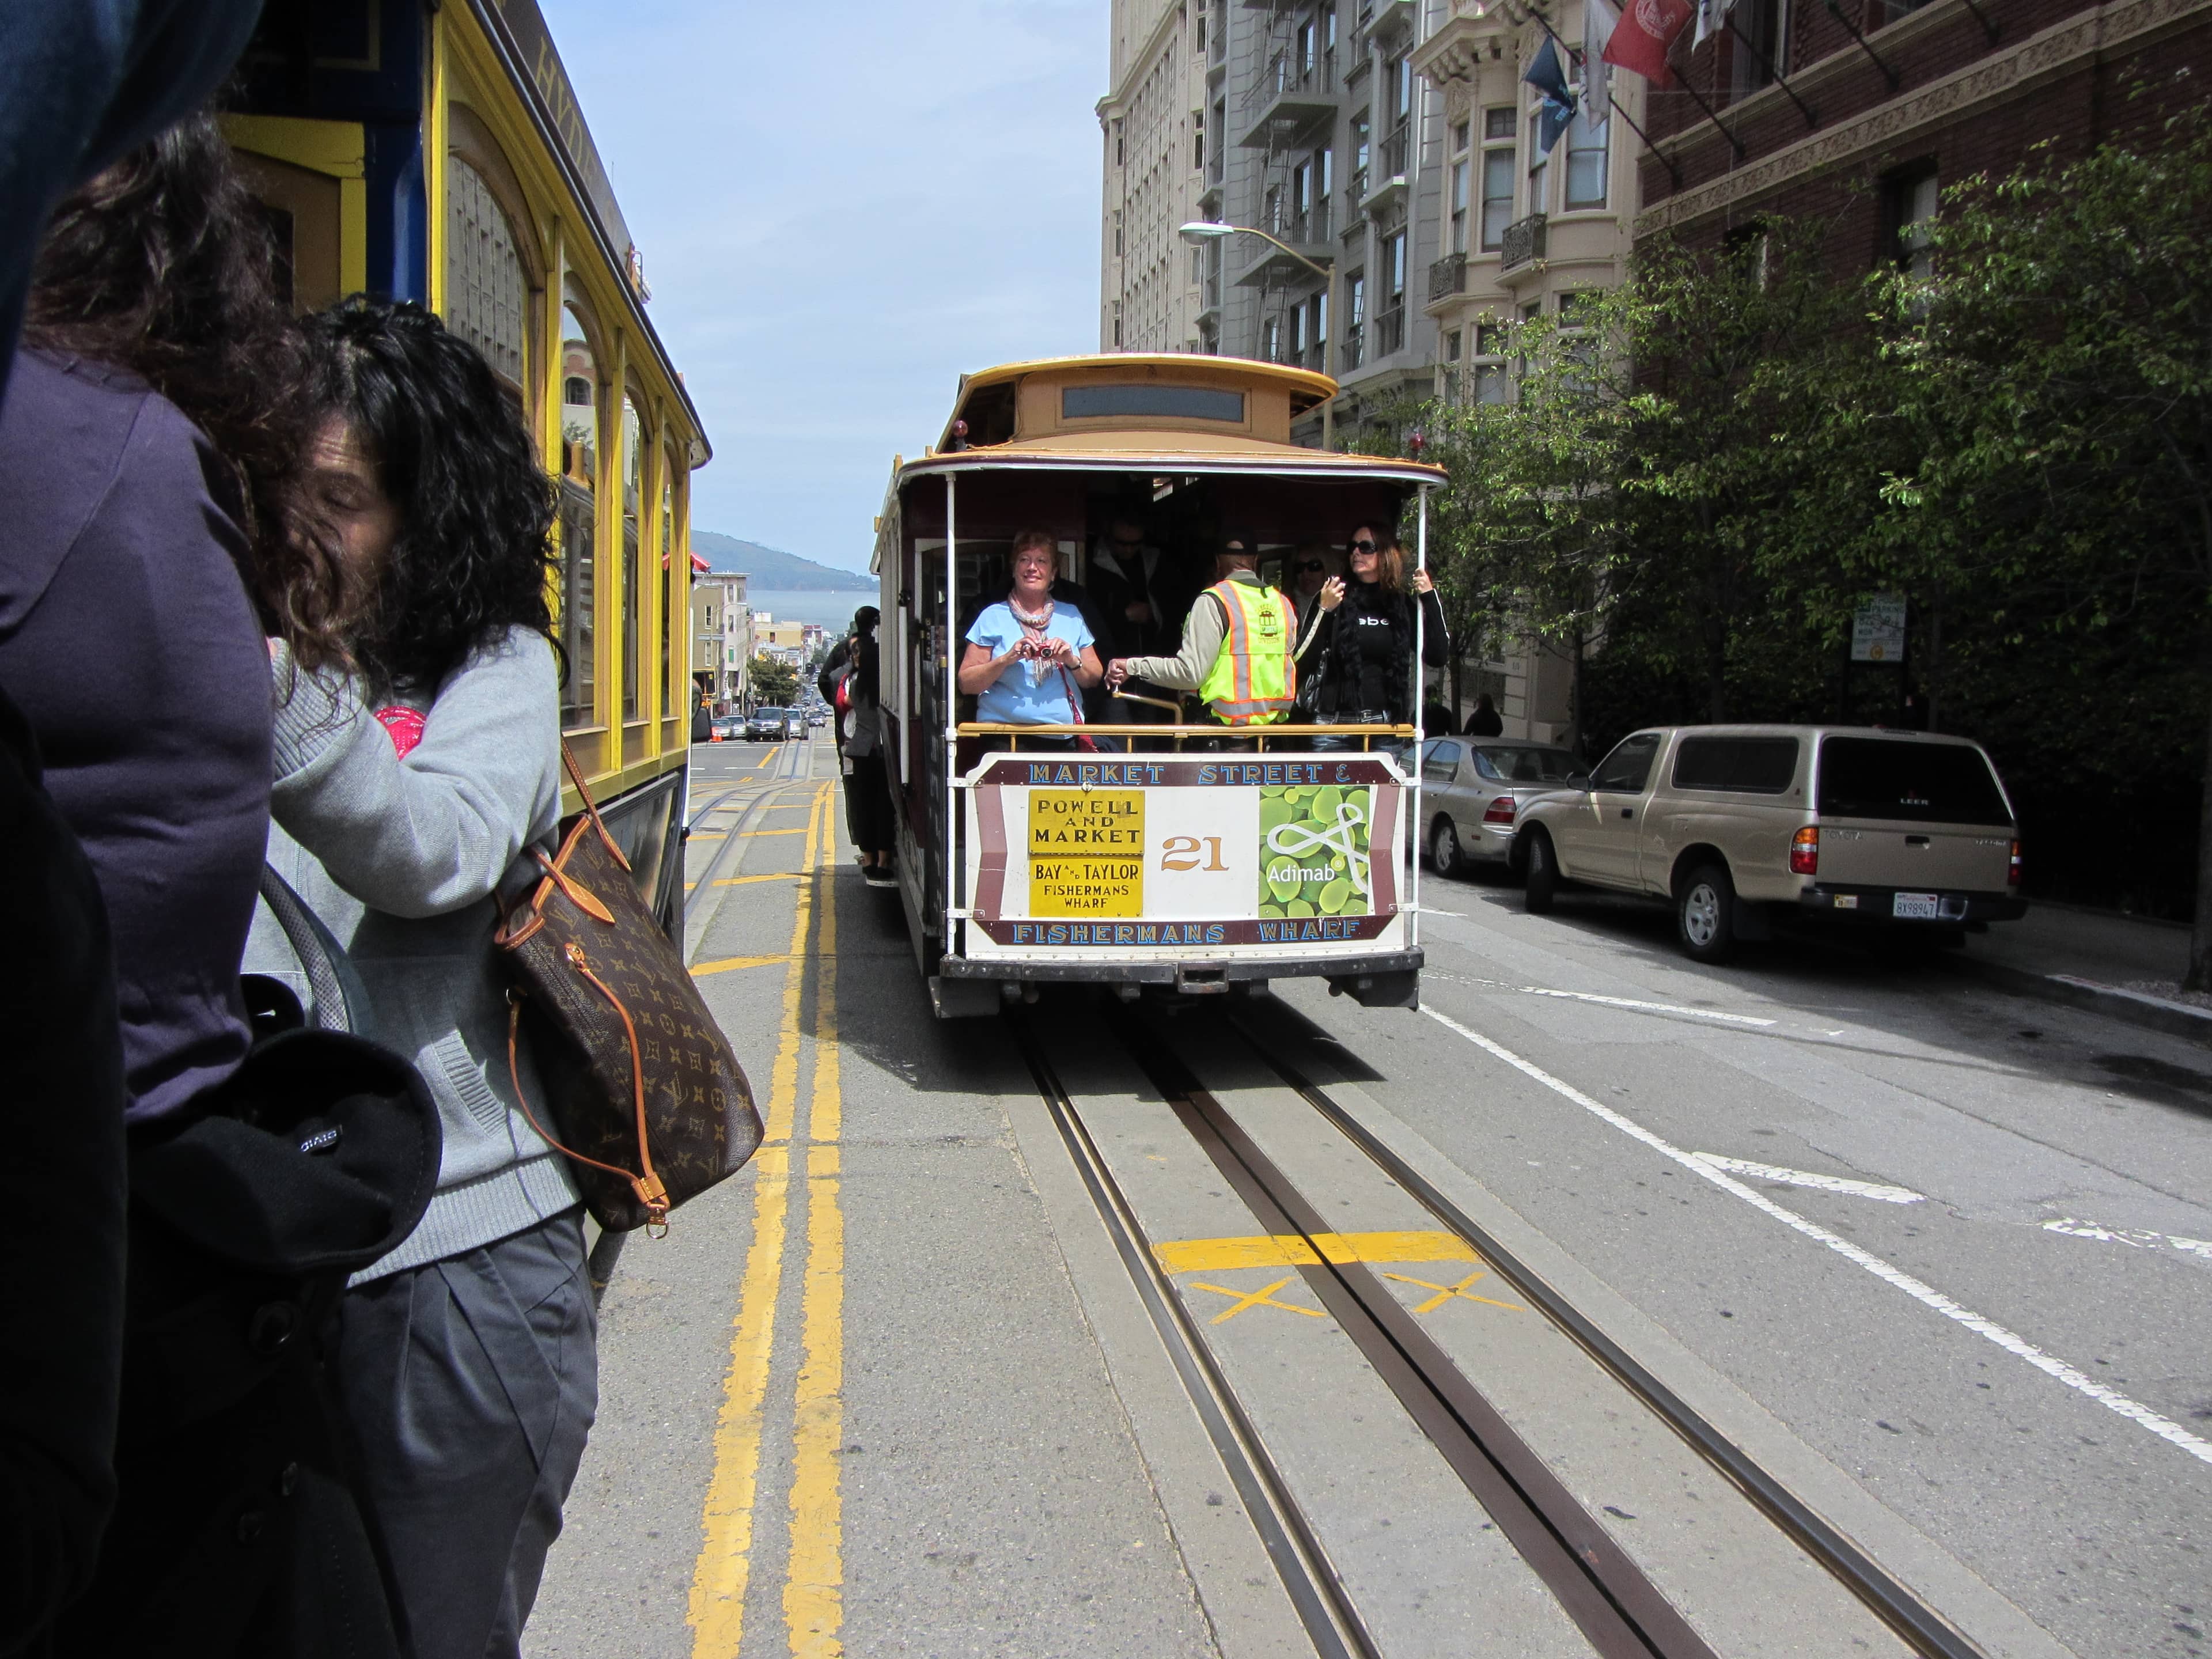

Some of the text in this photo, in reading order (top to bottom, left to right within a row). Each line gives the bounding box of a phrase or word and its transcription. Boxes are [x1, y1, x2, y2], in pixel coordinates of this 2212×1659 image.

[1029, 764, 1165, 784] MARKET
[1198, 764, 1323, 784] STREET
[1037, 800, 1138, 815] POWELL
[1900, 797, 1930, 806] LEER
[1065, 817, 1115, 827] AND
[1035, 830, 1140, 843] MARKET
[1824, 830, 1864, 841] TOYOTA
[1162, 836, 1230, 872] 21
[1036, 864, 1061, 880] BAY
[1084, 864, 1139, 880] TAYLOR
[1267, 863, 1335, 882] Adimab
[1043, 885, 1129, 896] FISHERMANS
[1065, 898, 1109, 908] WHARF
[1896, 902, 1935, 916] 8X98947
[1013, 919, 1360, 945] FISHERMANS WHARF
